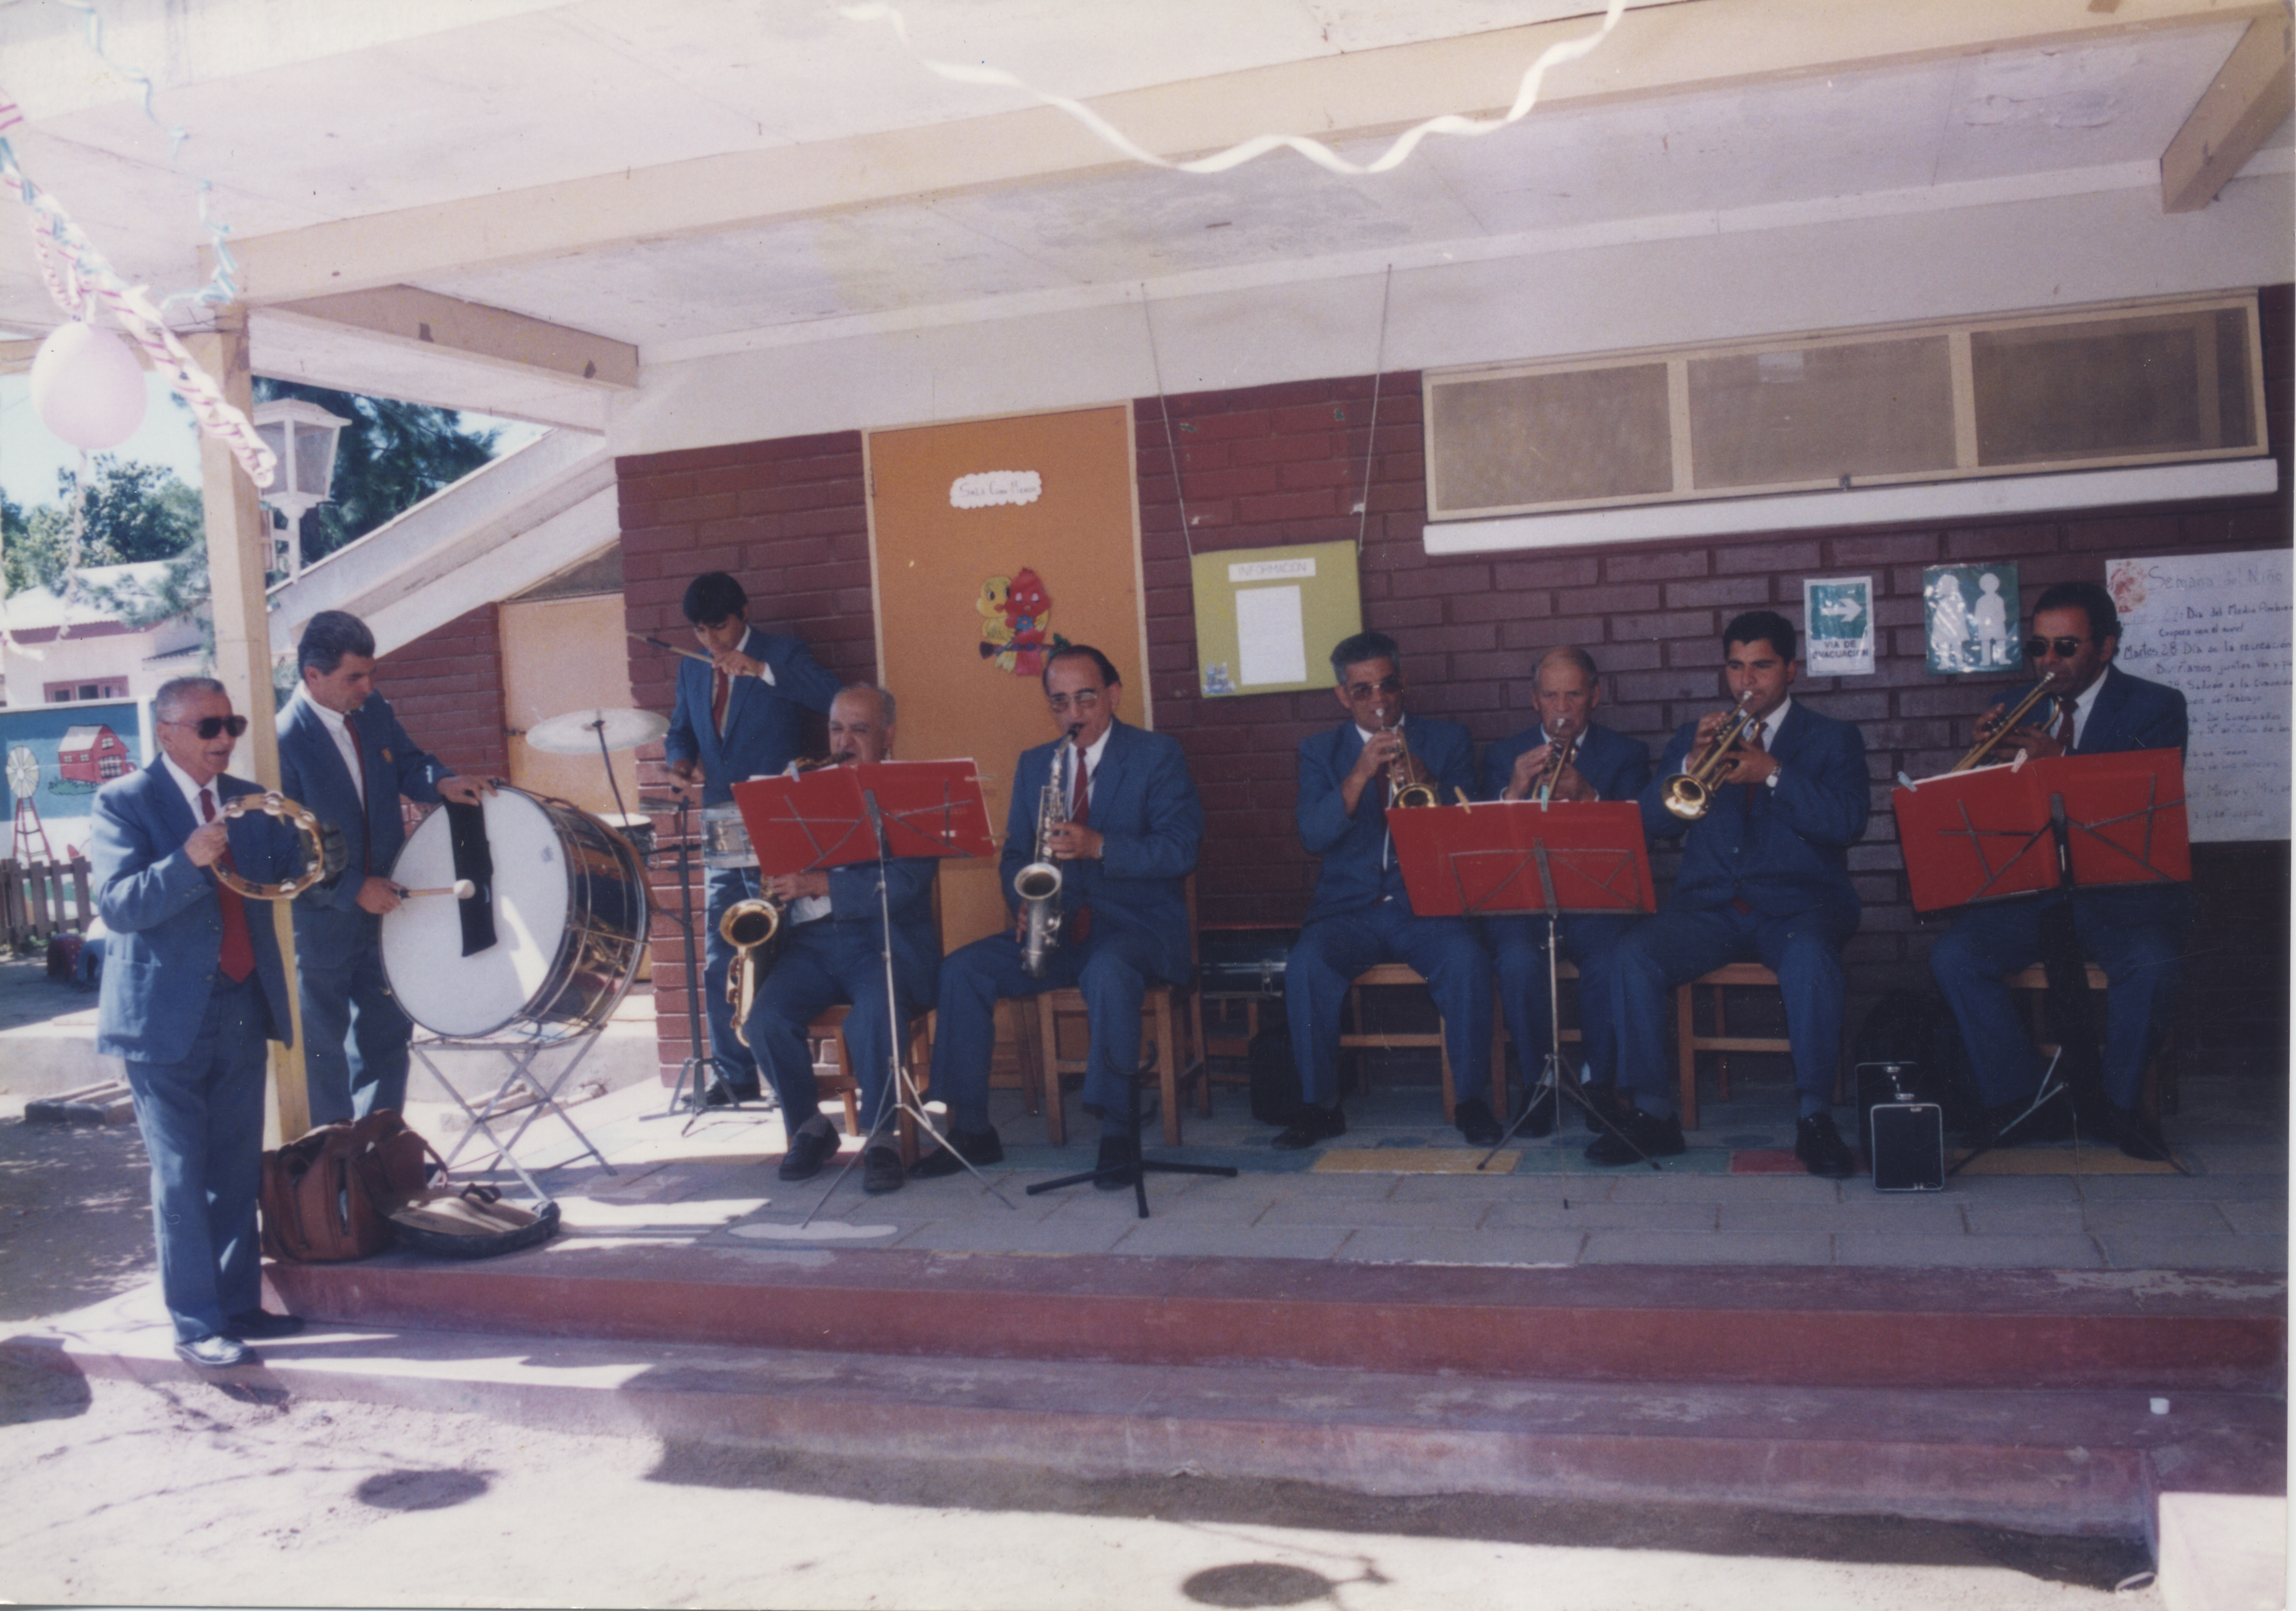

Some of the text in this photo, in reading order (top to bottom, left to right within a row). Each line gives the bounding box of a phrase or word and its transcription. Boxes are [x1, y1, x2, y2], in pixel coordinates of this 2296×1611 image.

[2148, 565, 2214, 591] Semana
[2248, 566, 2282, 585] Niño
[2210, 606, 2223, 617] del
[2229, 604, 2256, 615] Medio
[1843, 639, 1857, 649] DE
[2124, 642, 2158, 658] Martes
[2161, 641, 2177, 656] 28
[2225, 640, 2234, 652] la
[2241, 677, 2249, 688] la
